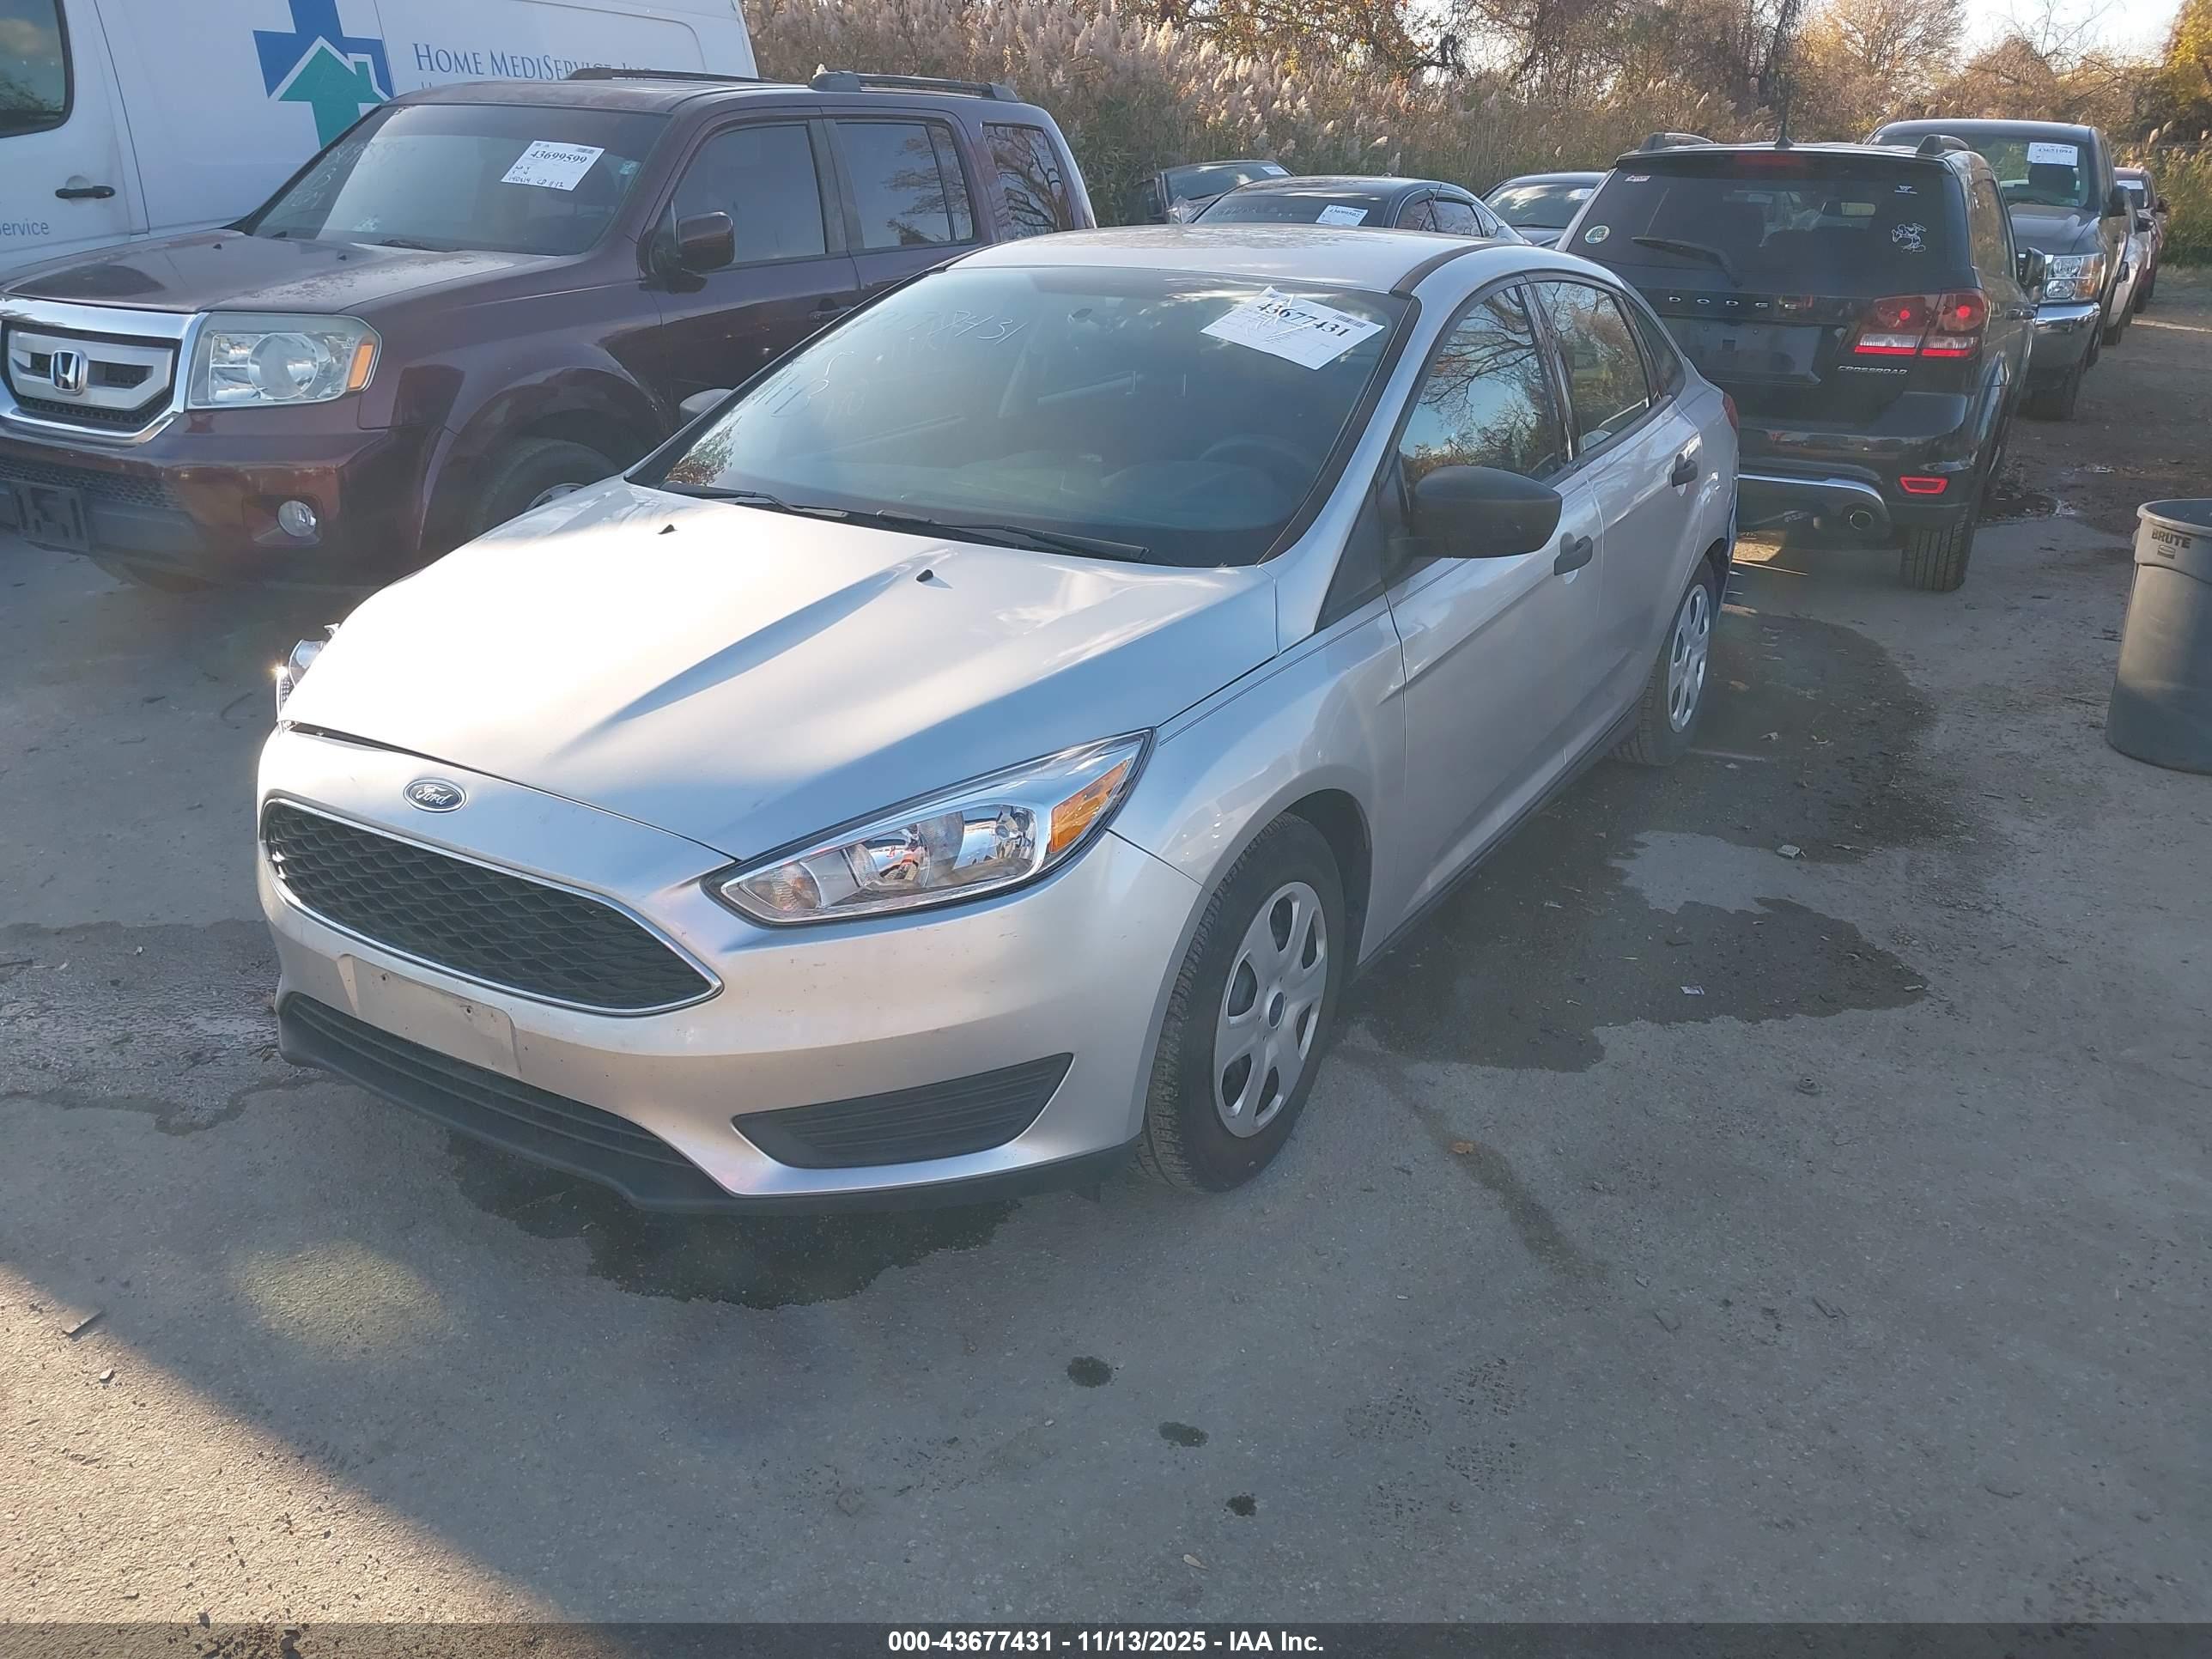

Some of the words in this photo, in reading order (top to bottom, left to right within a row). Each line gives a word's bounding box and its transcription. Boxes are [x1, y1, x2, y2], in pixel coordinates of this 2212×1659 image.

[412, 43, 484, 76] HOME
[531, 150, 587, 164] 43699599
[0, 218, 50, 236] ervice
[1668, 296, 1800, 310] DODGE
[1256, 303, 1352, 337] 43677431
[1838, 365, 1909, 376] CROSSROAD
[2152, 529, 2191, 549] BRUTE
[416, 785, 453, 805] Ford
